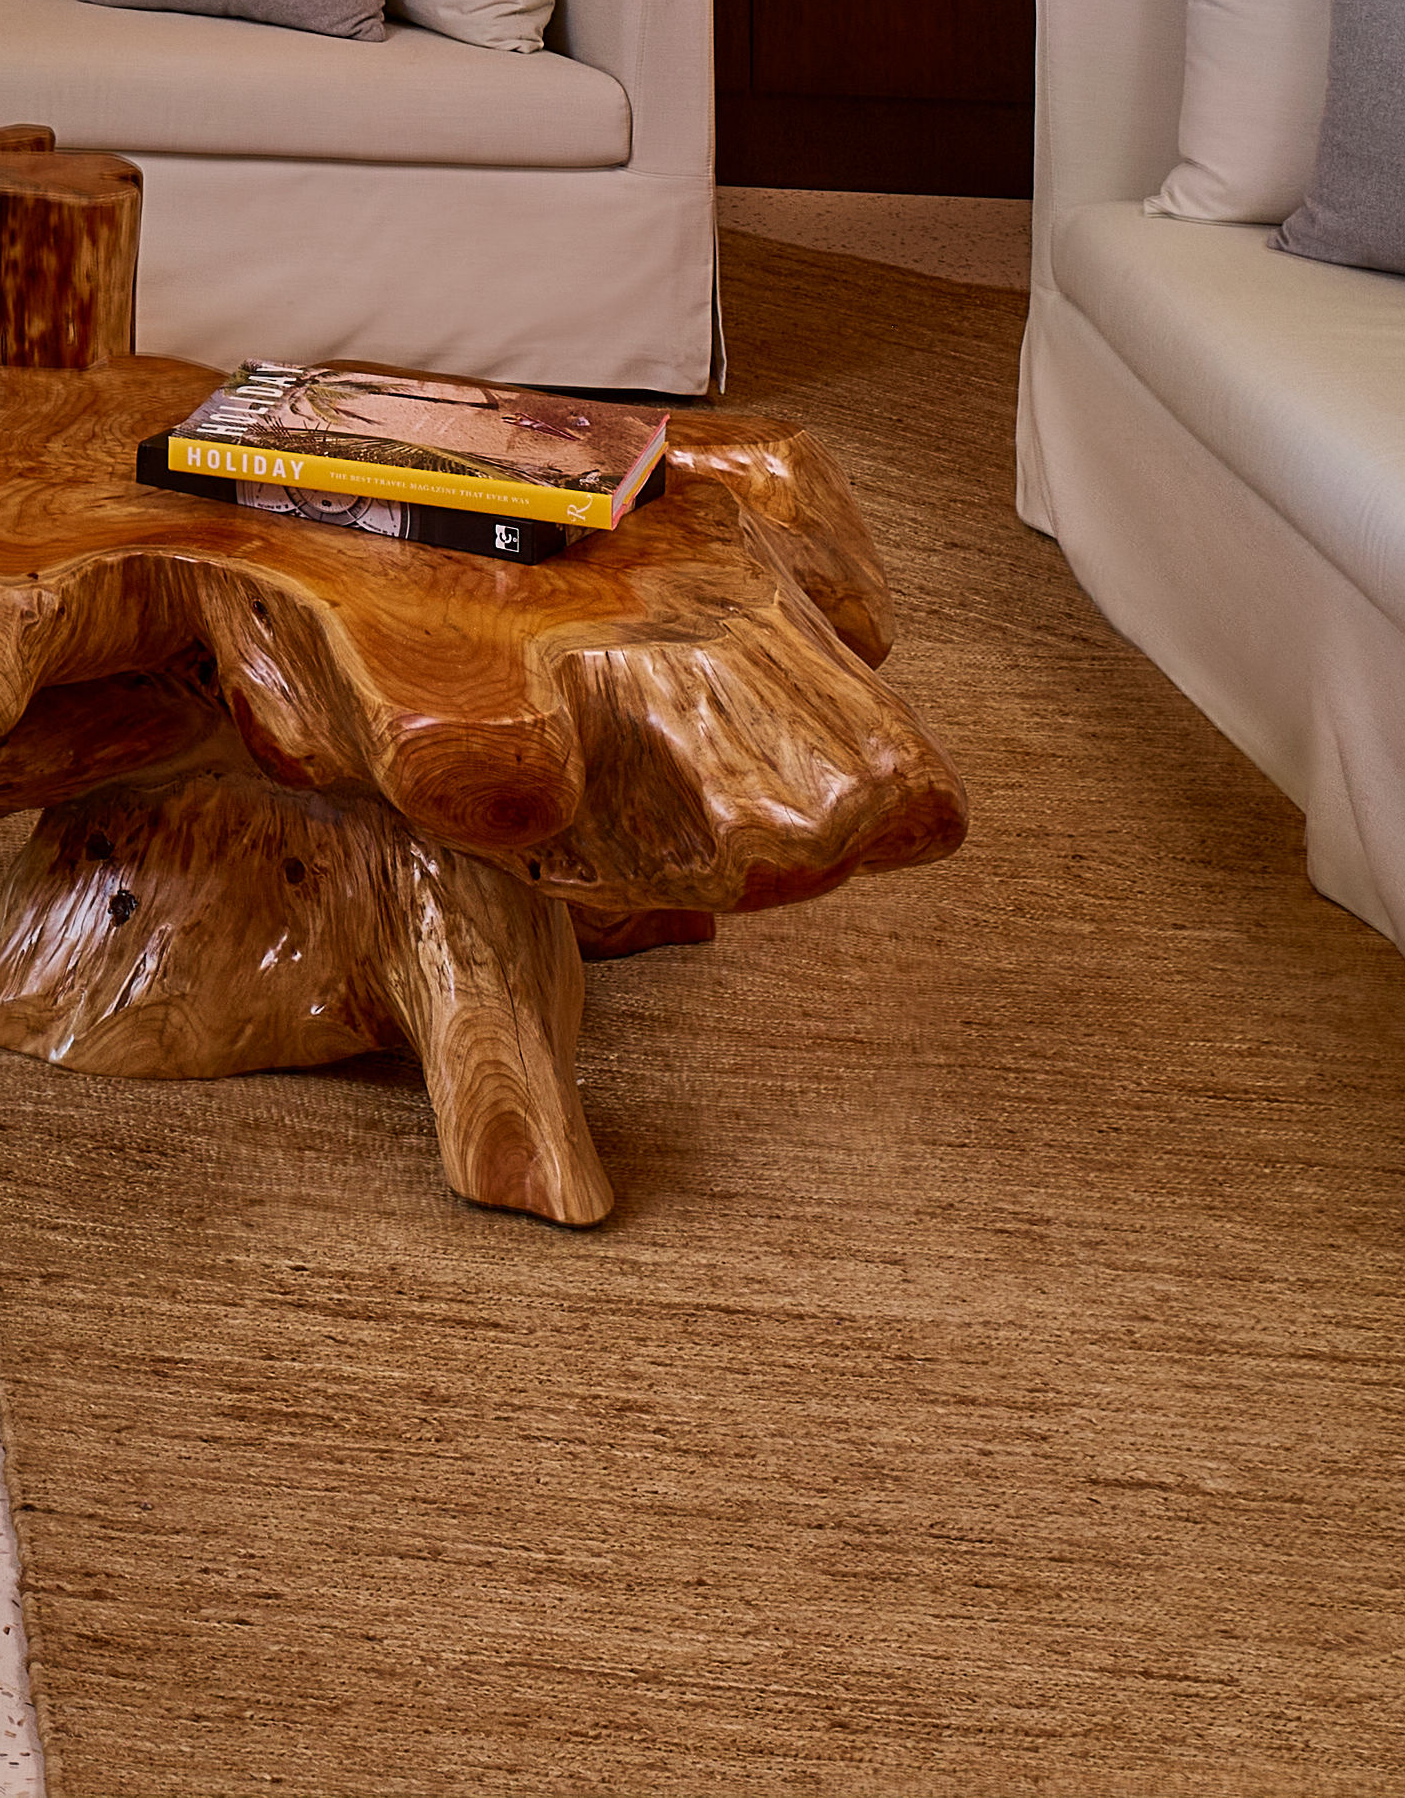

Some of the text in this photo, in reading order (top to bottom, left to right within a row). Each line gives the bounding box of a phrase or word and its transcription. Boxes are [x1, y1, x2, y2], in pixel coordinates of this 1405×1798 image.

[196, 363, 304, 438] HOLIDAY
[187, 445, 304, 481] HOLIDAY
[330, 471, 530, 505] THE BEST TRAVEL MAGAZINE THAT EVER WAS
